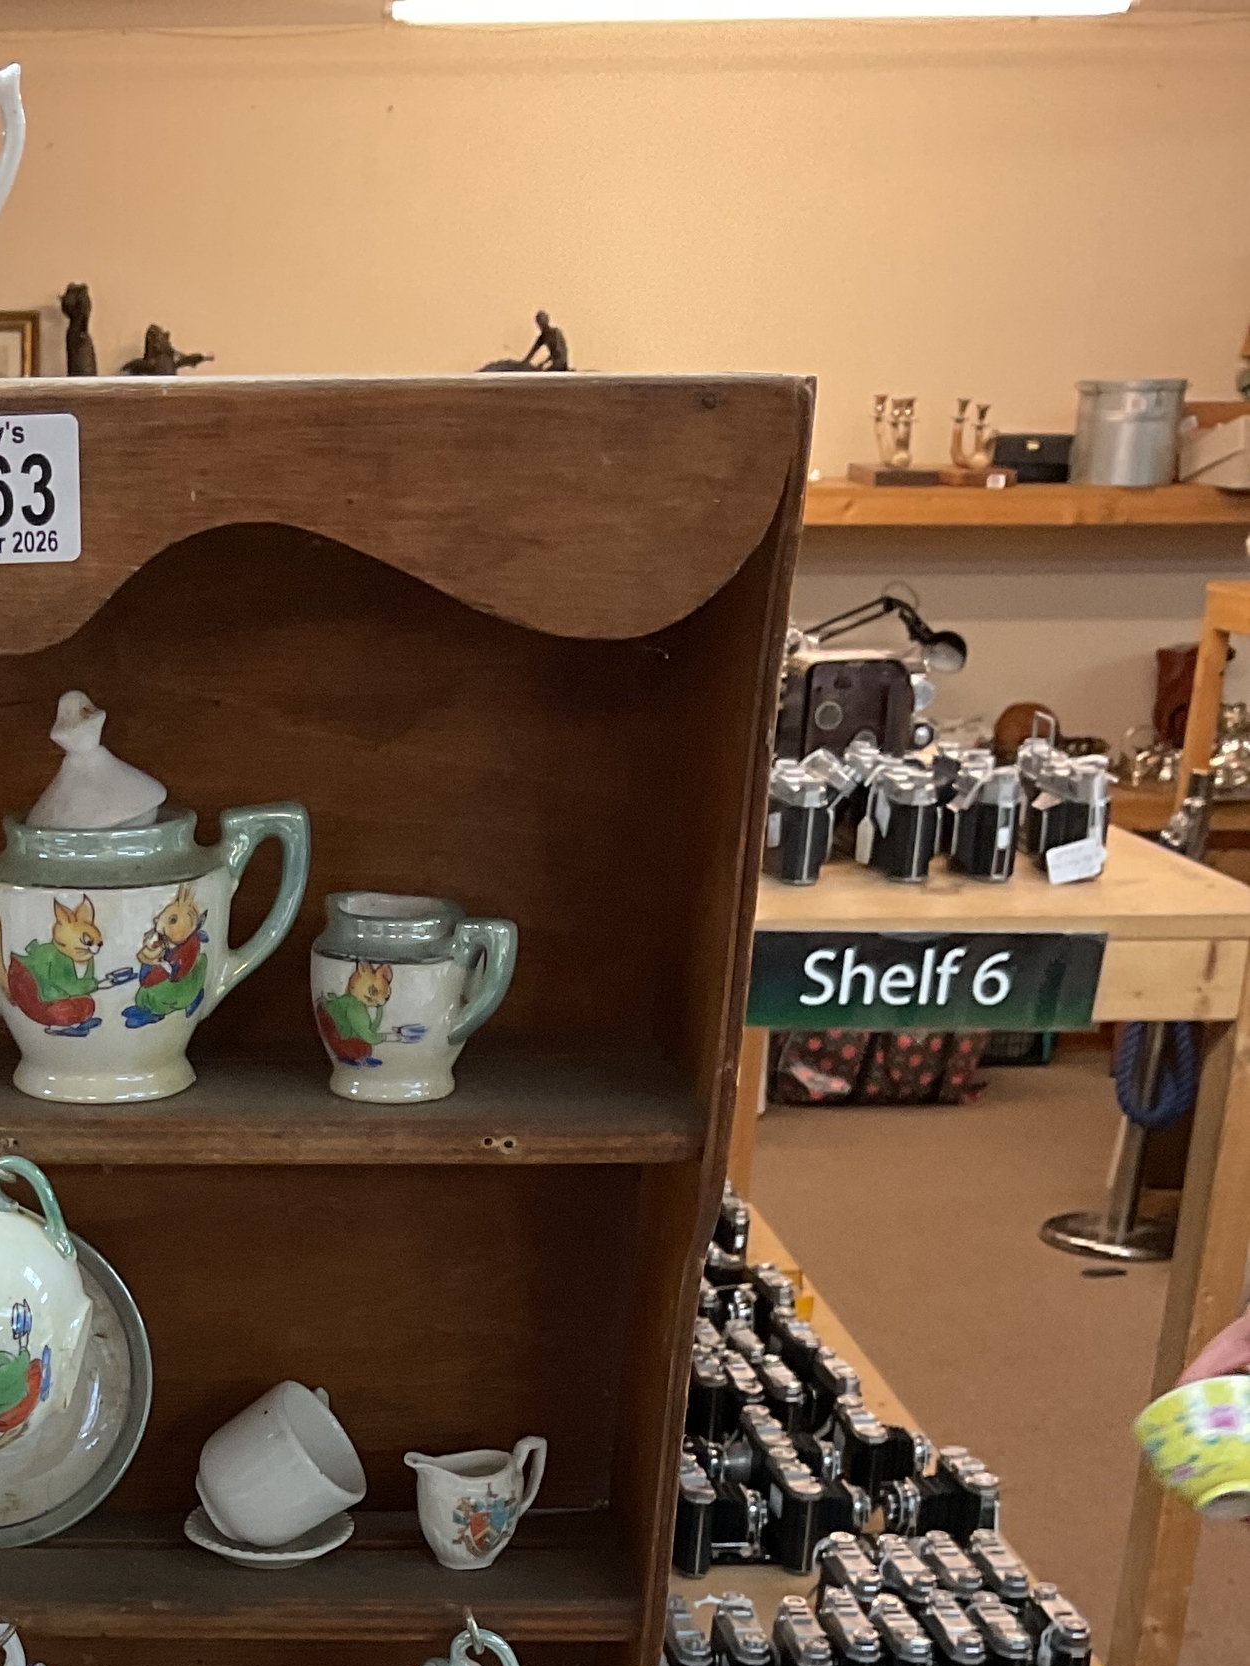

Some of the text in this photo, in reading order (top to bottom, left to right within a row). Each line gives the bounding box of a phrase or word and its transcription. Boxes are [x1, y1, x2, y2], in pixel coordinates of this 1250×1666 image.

[12, 530, 58, 553] 2026
[799, 946, 1012, 1005] Shelf 6
